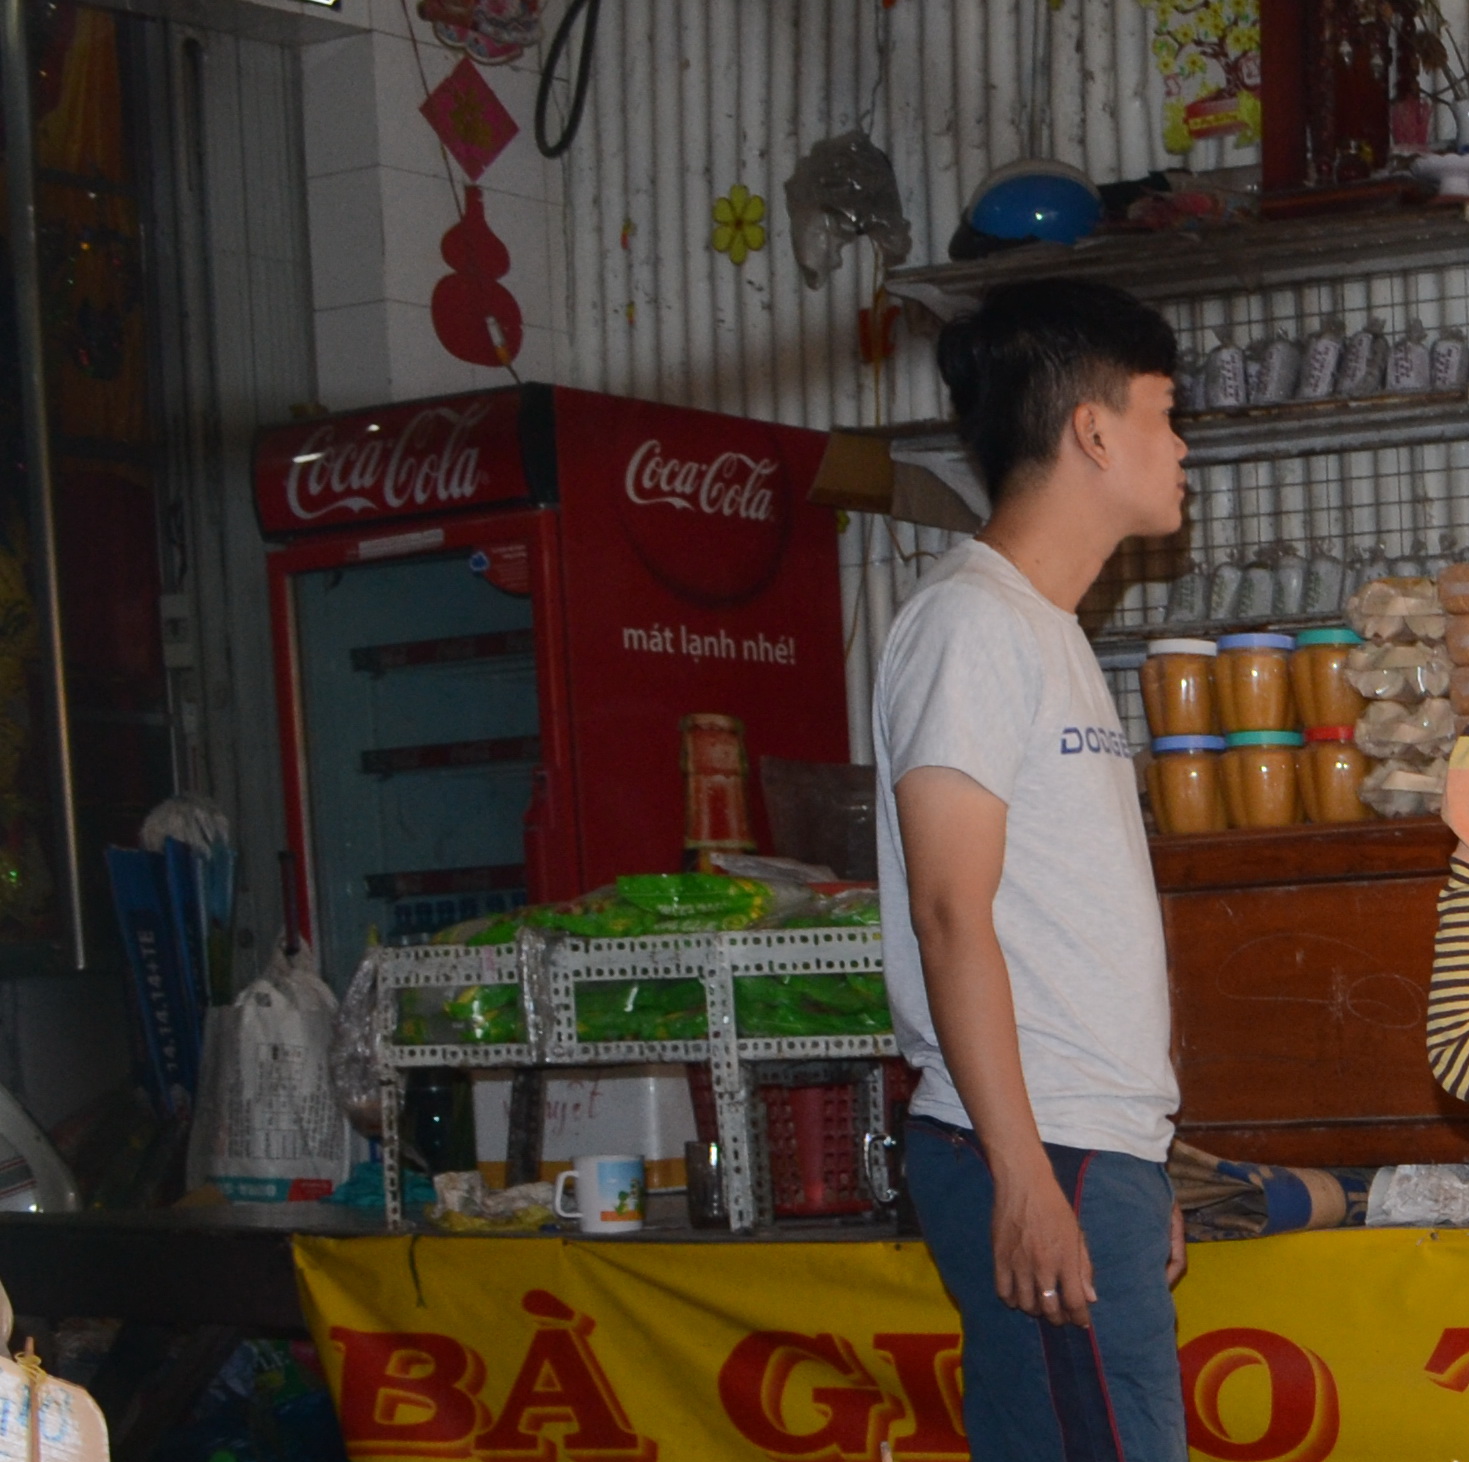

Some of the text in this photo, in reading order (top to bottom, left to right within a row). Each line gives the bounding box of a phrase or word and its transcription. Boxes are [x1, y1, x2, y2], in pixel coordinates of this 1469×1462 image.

[286, 403, 489, 520] Coca-Cola
[625, 439, 779, 521] Coca-Cola
[623, 622, 796, 665] mát lạnh nhé!
[1060, 726, 1132, 758] DODGE
